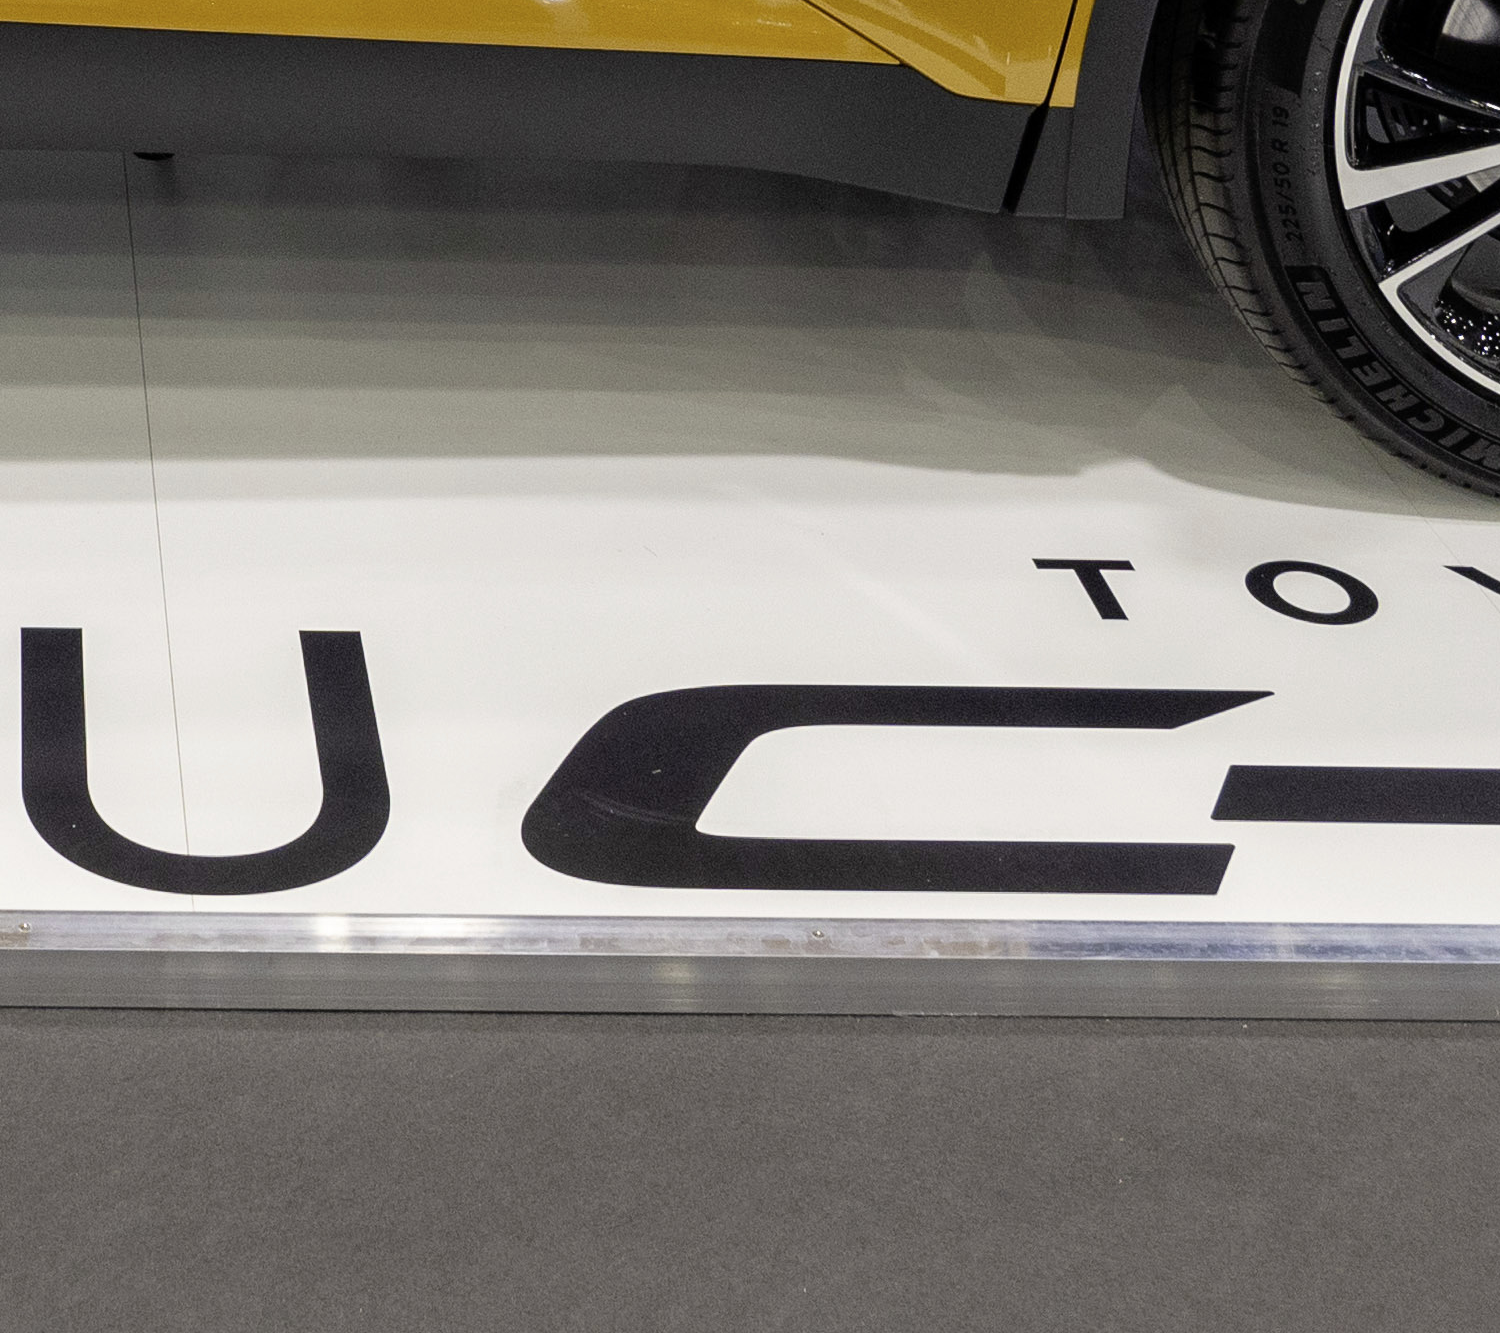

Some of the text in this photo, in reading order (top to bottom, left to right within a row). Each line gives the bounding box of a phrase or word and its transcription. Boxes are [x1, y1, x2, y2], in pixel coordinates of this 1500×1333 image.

[1270, 104, 1303, 243] 225/50 R 19
